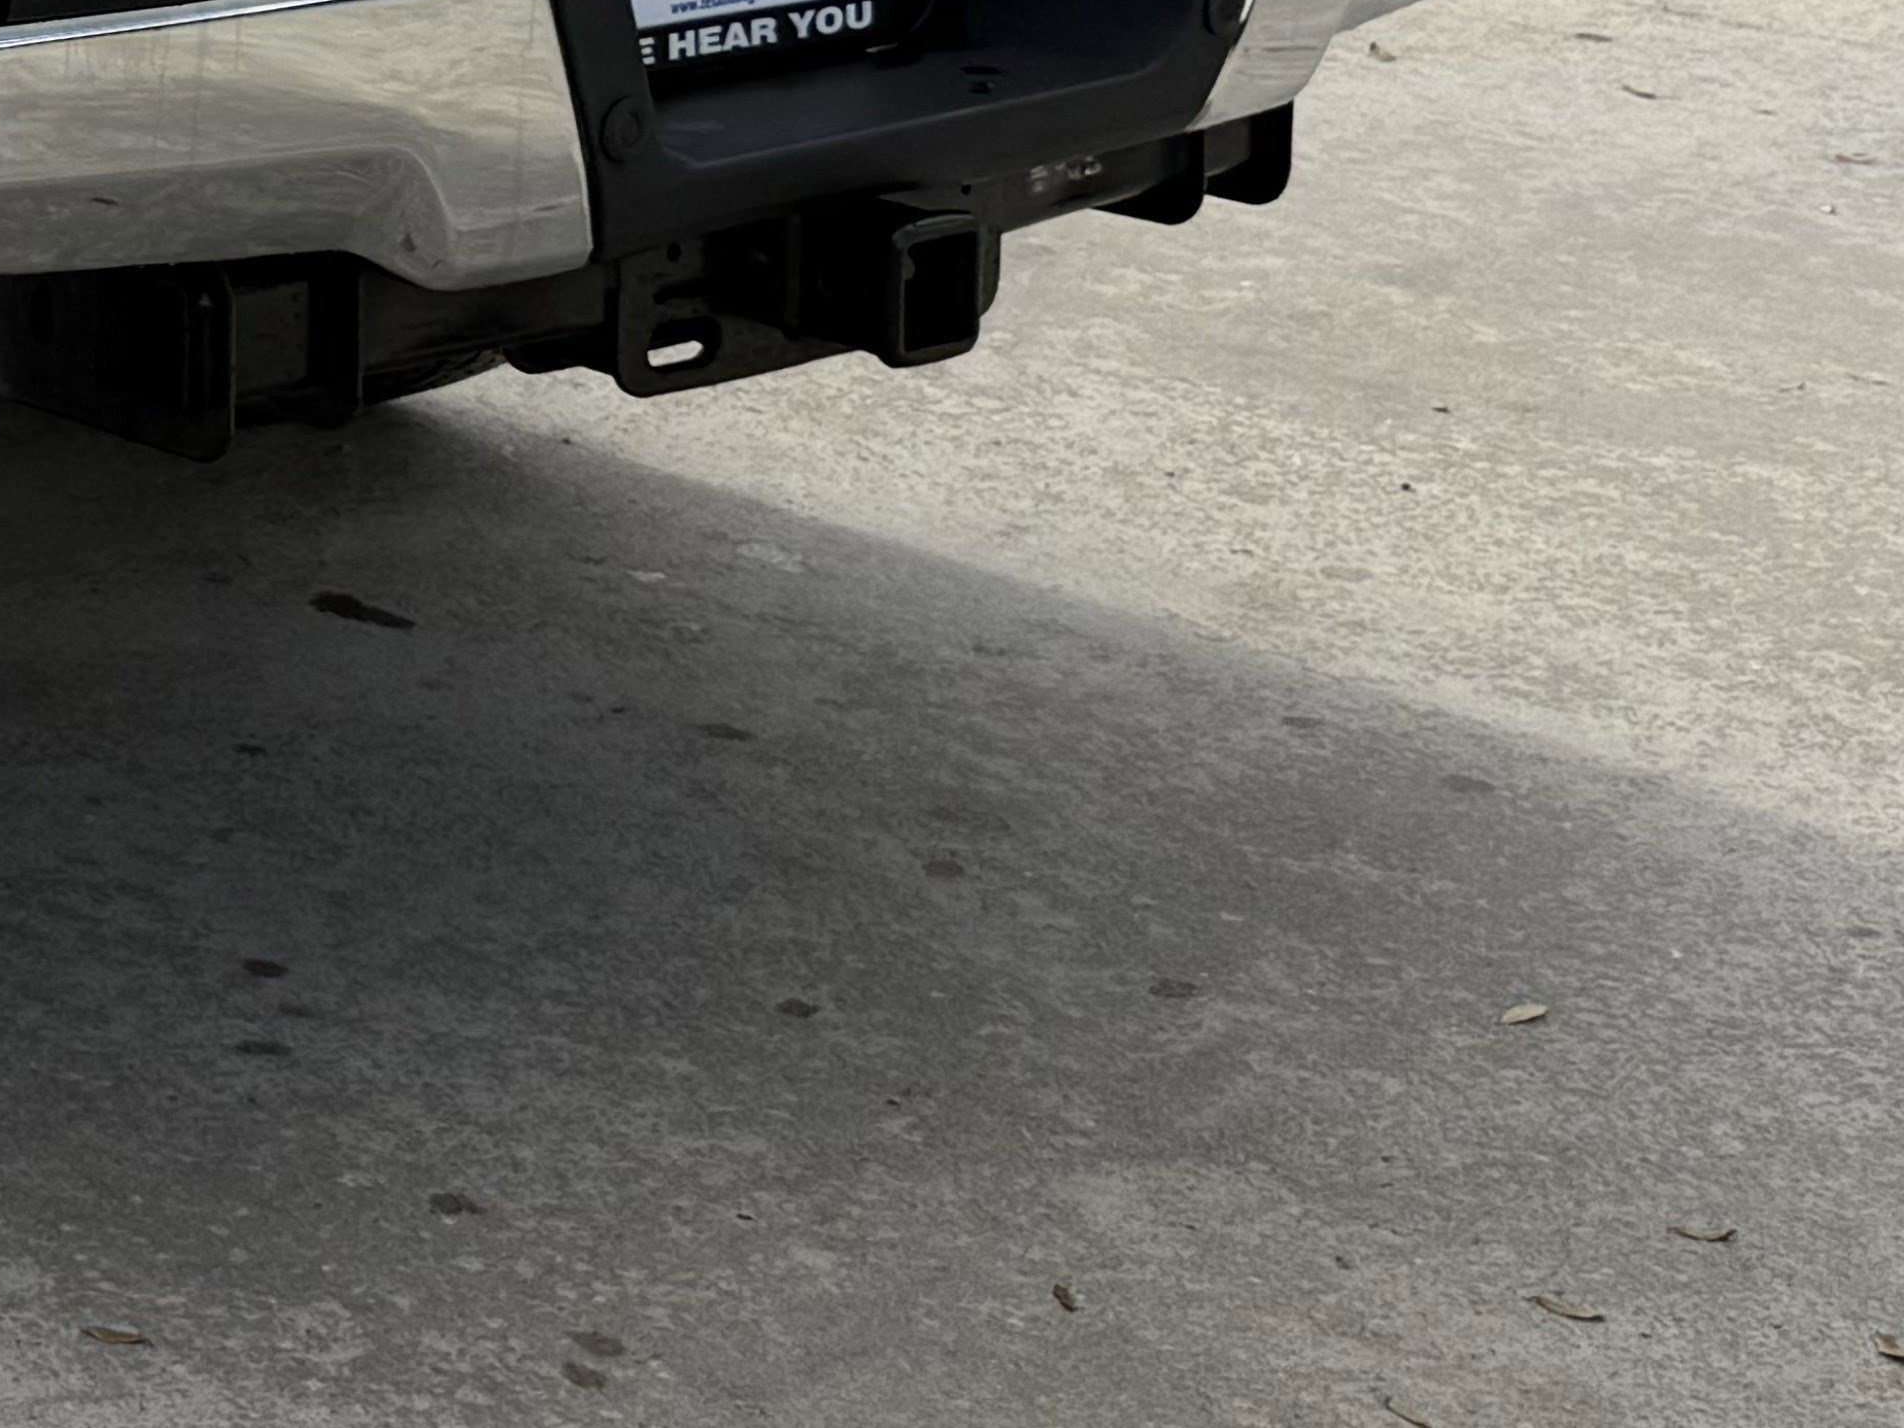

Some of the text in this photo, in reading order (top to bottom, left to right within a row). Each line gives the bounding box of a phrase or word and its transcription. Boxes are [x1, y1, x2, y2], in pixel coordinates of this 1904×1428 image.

[639, 0, 874, 66] E HEAR YOU
